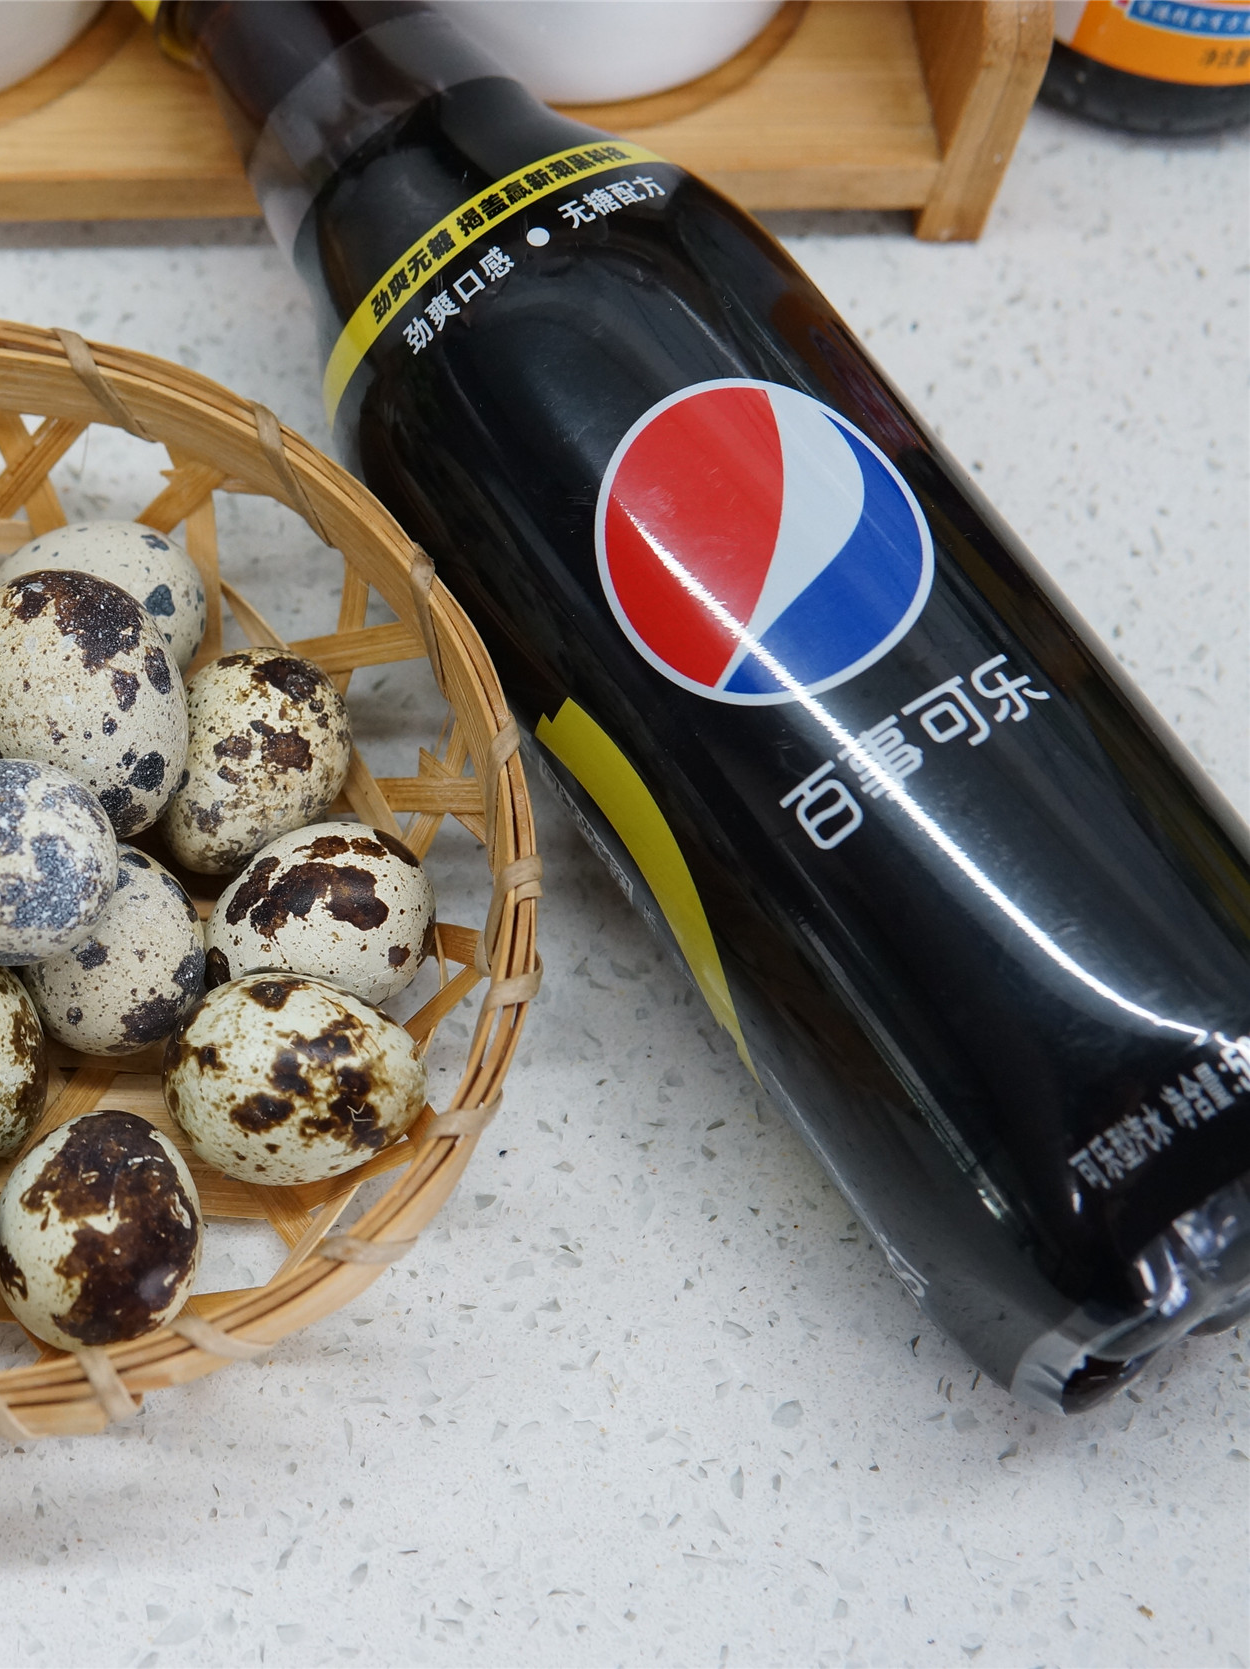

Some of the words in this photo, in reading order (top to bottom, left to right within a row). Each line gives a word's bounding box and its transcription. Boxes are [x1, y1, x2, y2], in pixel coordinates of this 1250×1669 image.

[369, 228, 458, 325] 劲爽无糖
[456, 146, 631, 237] 揭盖赢新潮黑科技
[402, 245, 516, 355] 劲爽口感
[557, 175, 667, 229] 无糖配方
[1067, 1104, 1174, 1190] 可乐型汽水
